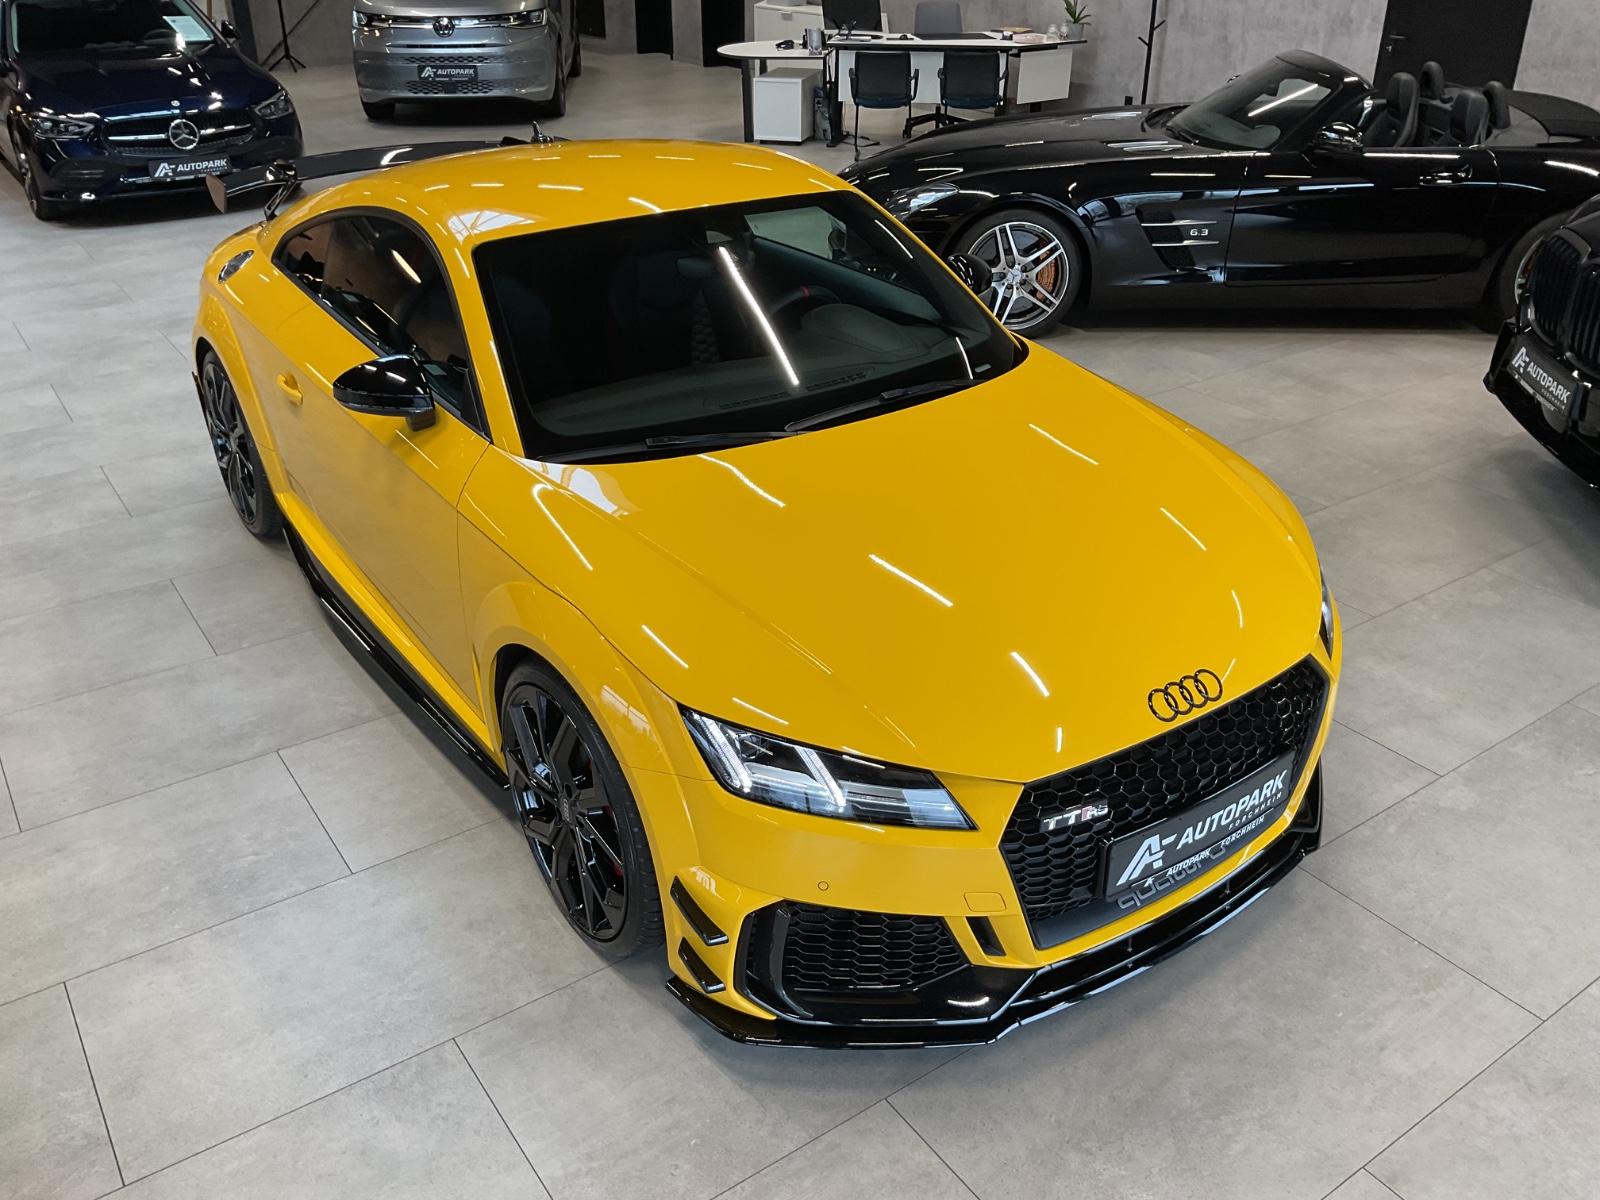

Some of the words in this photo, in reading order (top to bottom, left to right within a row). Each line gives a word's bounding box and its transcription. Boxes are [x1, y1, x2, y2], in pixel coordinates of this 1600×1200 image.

[177, 159, 227, 171] AUTOPARK
[1527, 361, 1570, 403] AUTOPARK
[1176, 770, 1287, 850] AUTOPARK
